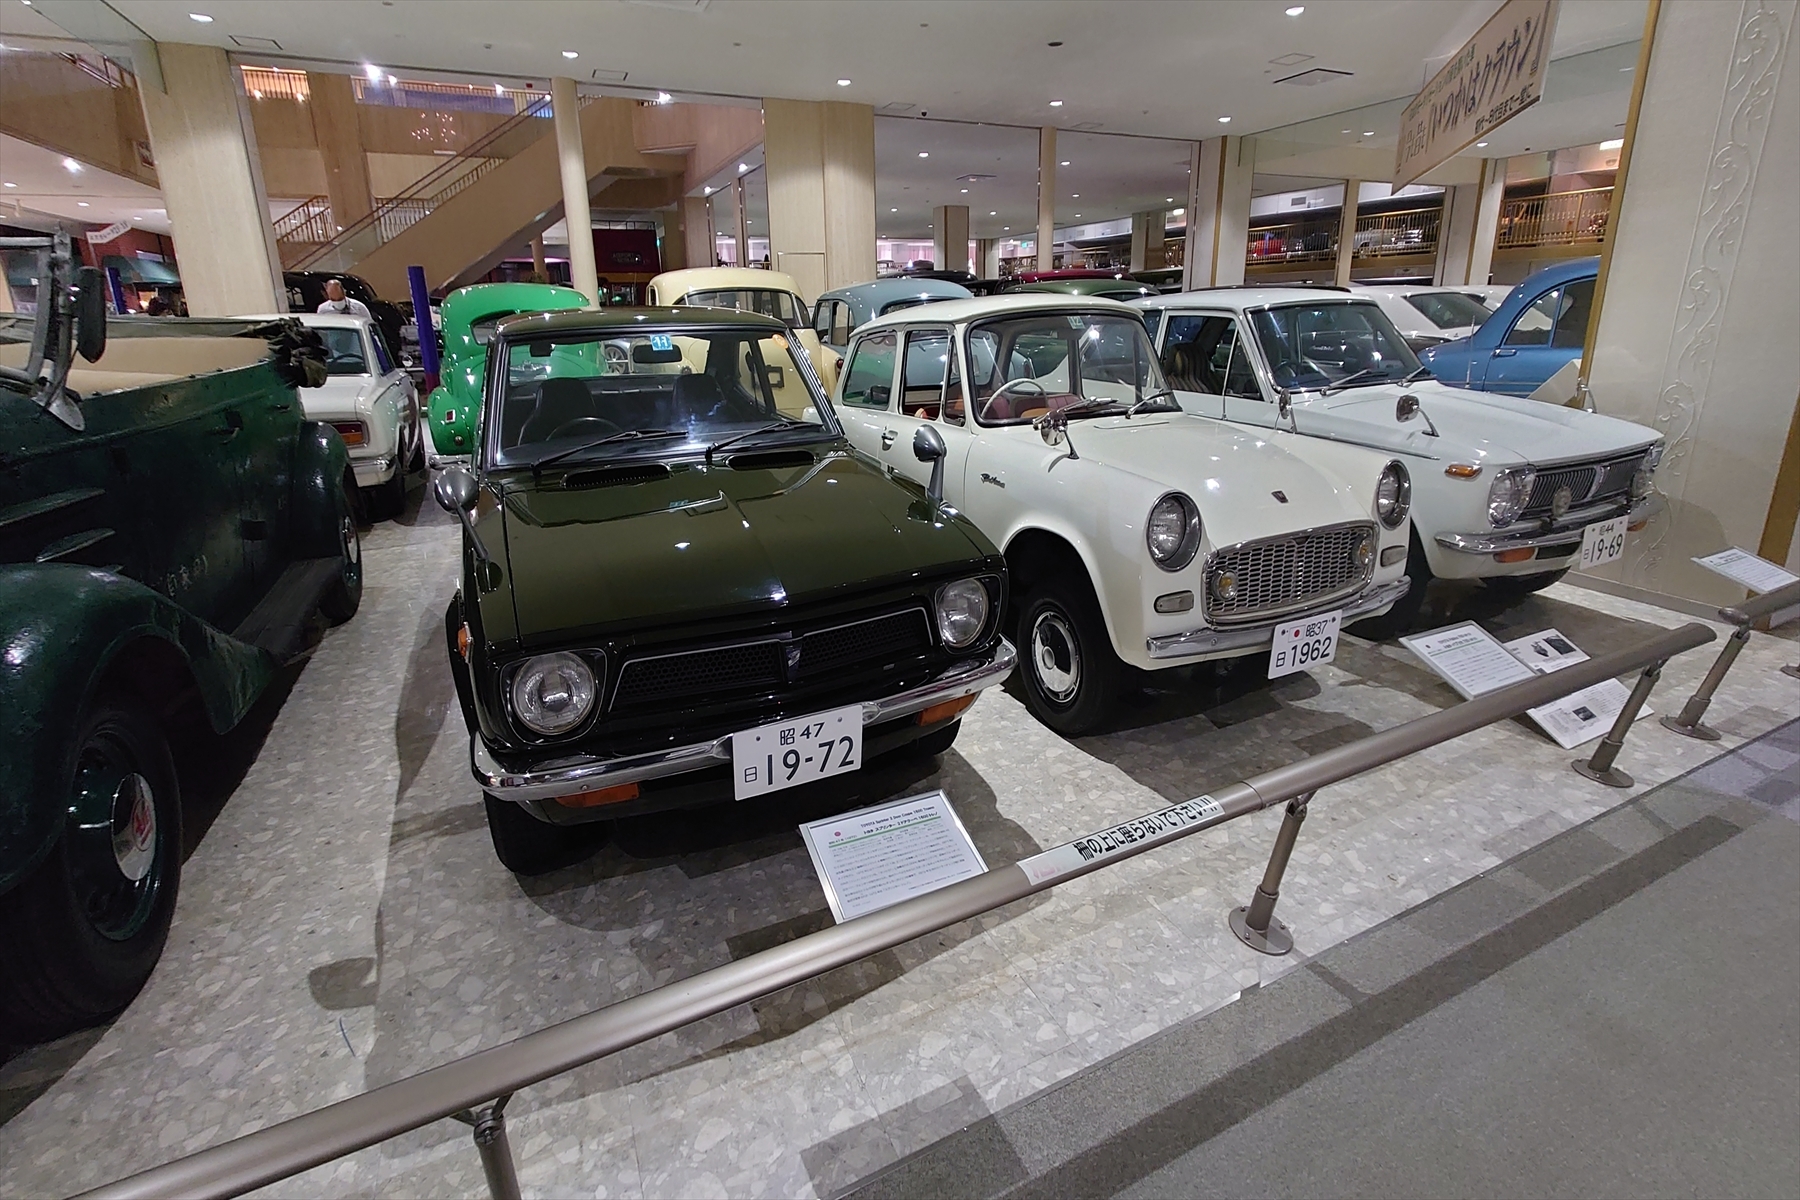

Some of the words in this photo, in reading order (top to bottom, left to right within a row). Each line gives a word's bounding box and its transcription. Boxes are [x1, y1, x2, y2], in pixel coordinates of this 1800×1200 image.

[652, 335, 668, 347] 11
[1583, 548, 1590, 560] 日
[1305, 619, 1328, 638] 昭37
[1276, 651, 1287, 668] 日
[1291, 635, 1332, 668] 1962
[744, 766, 758, 784] 日
[767, 735, 855, 786] 19-72
